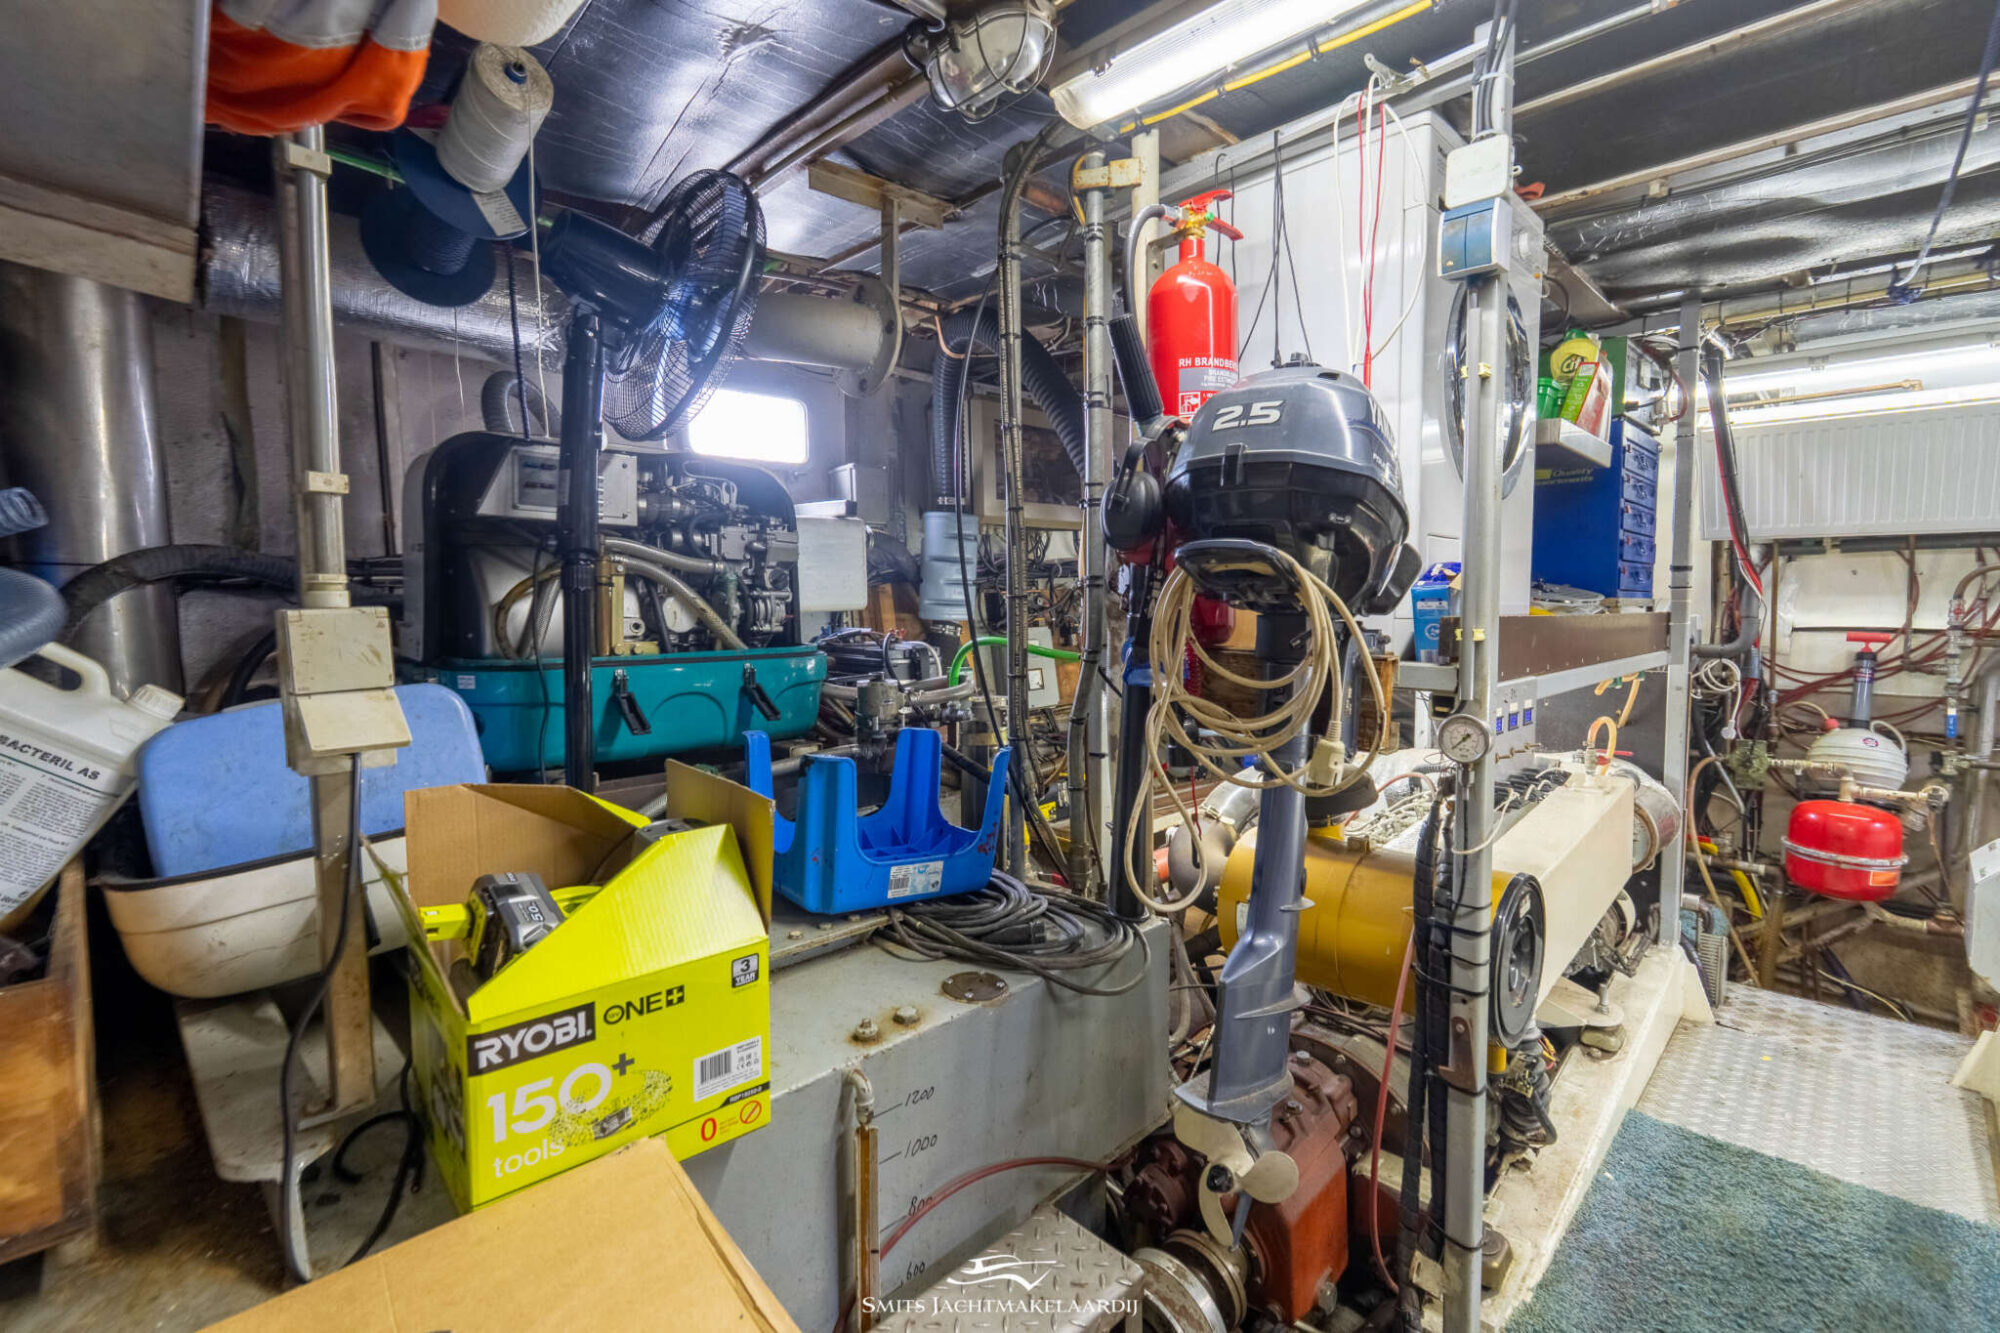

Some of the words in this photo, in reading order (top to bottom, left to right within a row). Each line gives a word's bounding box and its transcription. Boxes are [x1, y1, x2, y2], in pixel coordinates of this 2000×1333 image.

[1179, 358, 1192, 368] RH
[1212, 400, 1284, 432] 2.5
[77, 767, 101, 780] AS
[740, 959, 751, 973] 3
[735, 972, 757, 984] YEAR
[474, 1011, 588, 1069] RYOBI
[905, 1086, 935, 1107] 1200
[904, 1134, 938, 1158] 1000
[493, 1139, 565, 1178] tools
[906, 1261, 926, 1281] 600
